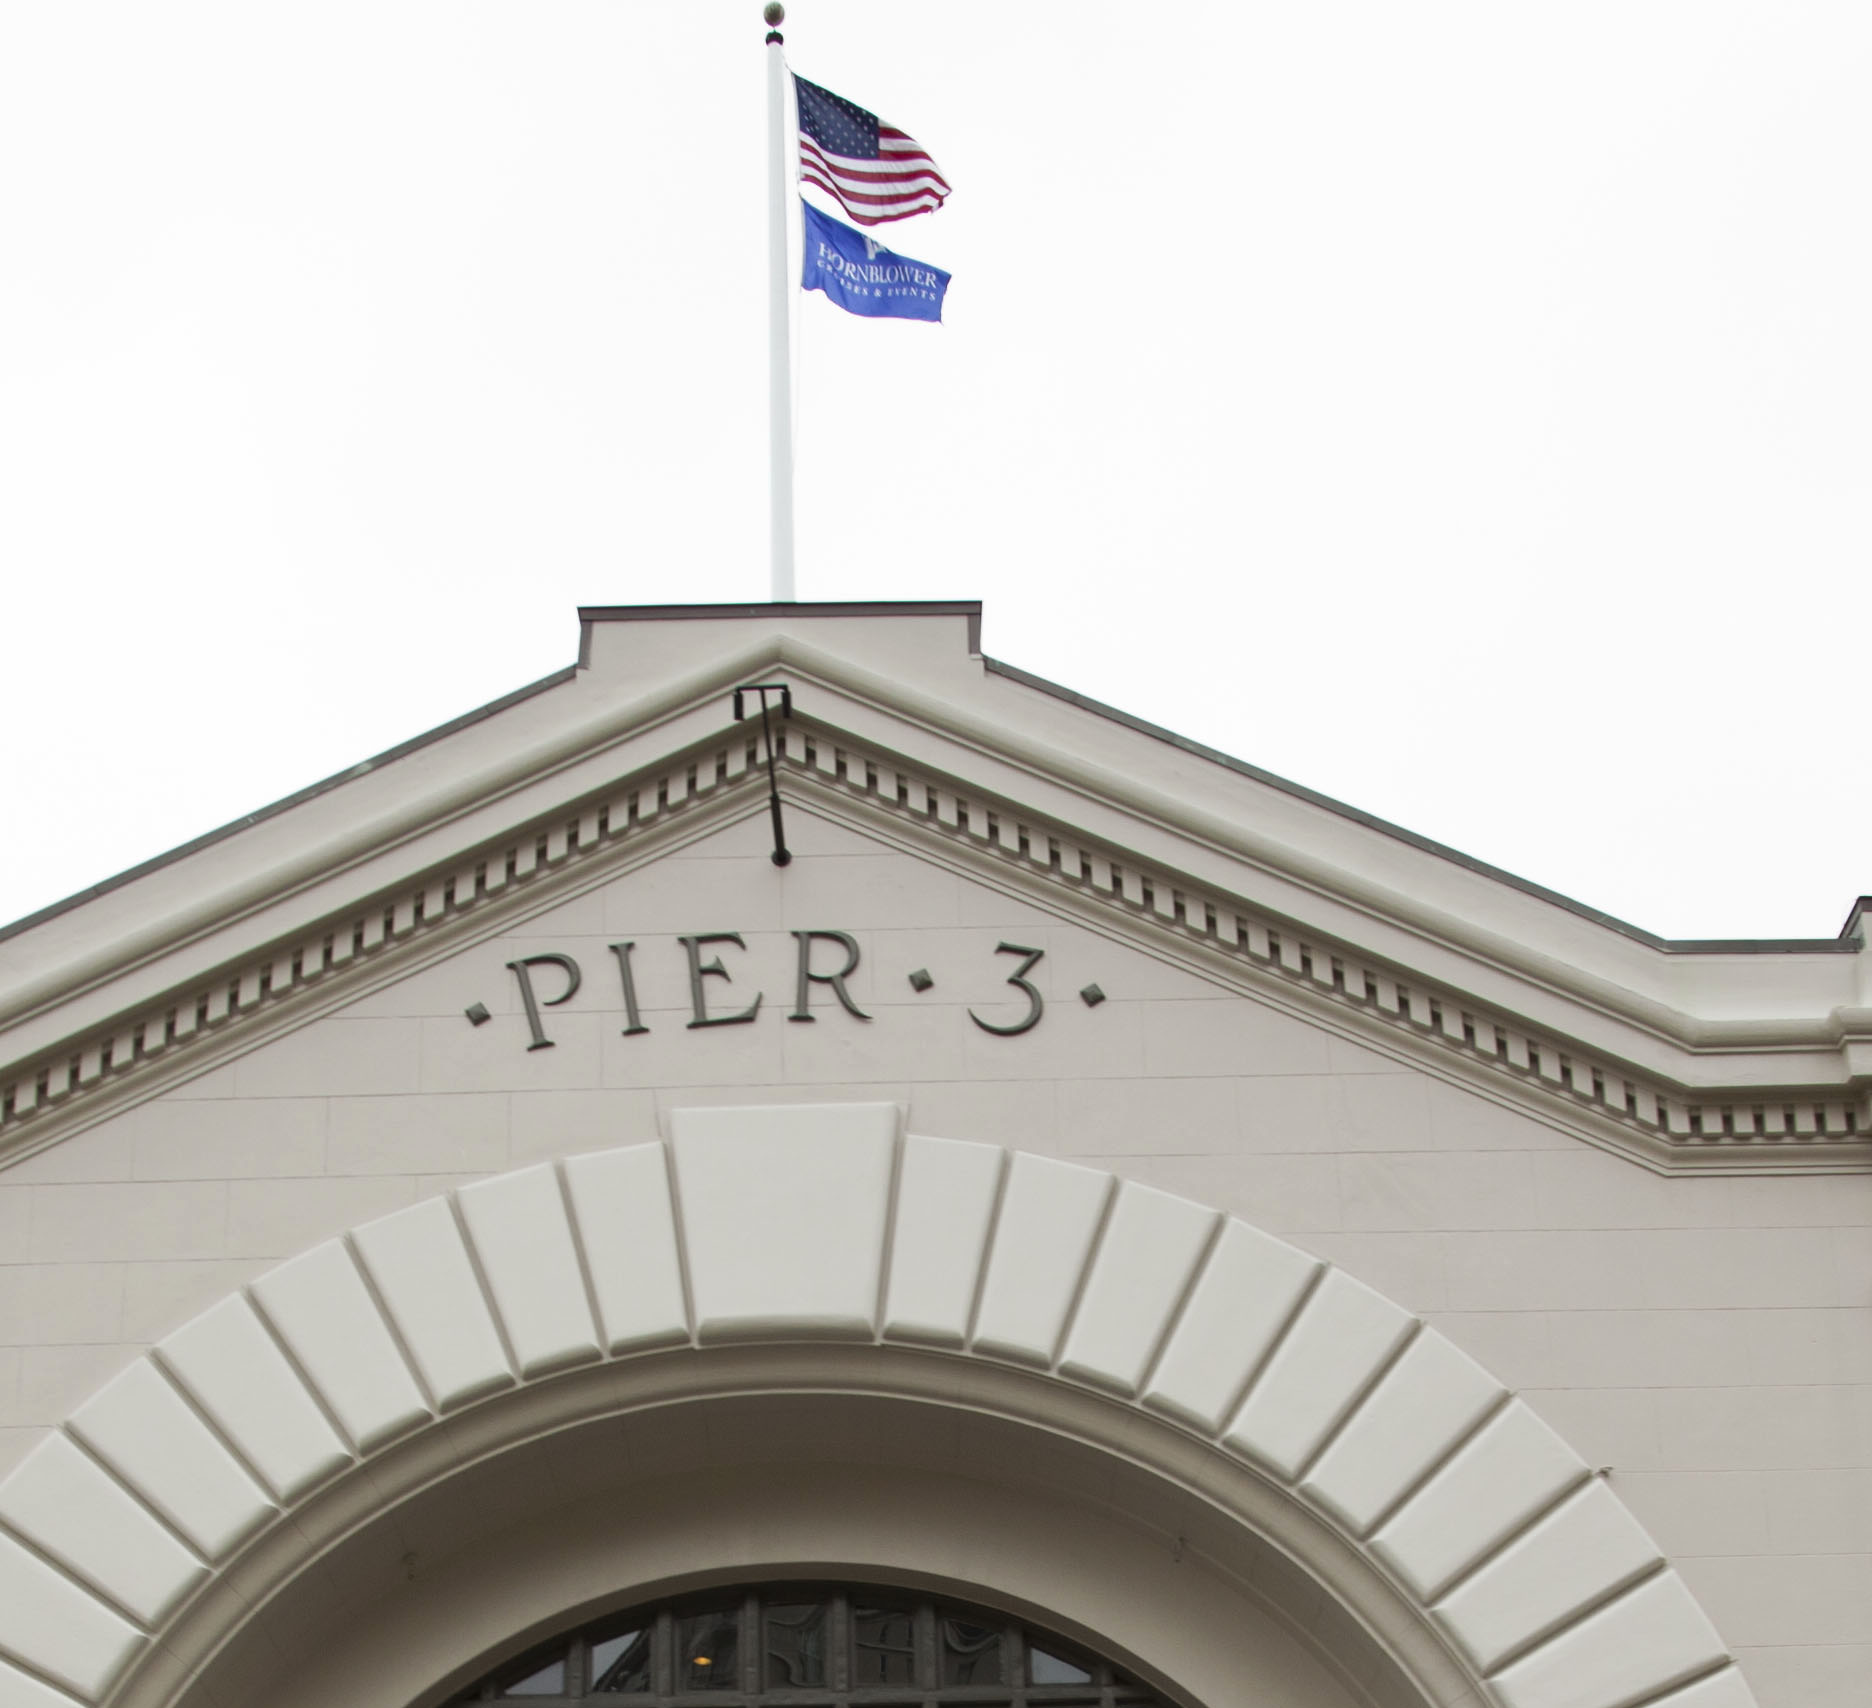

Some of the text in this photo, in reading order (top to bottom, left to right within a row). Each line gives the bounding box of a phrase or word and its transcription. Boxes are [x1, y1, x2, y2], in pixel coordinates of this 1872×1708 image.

[818, 242, 937, 289] HORNBLOWER
[505, 930, 1045, 1052] PIER 3
